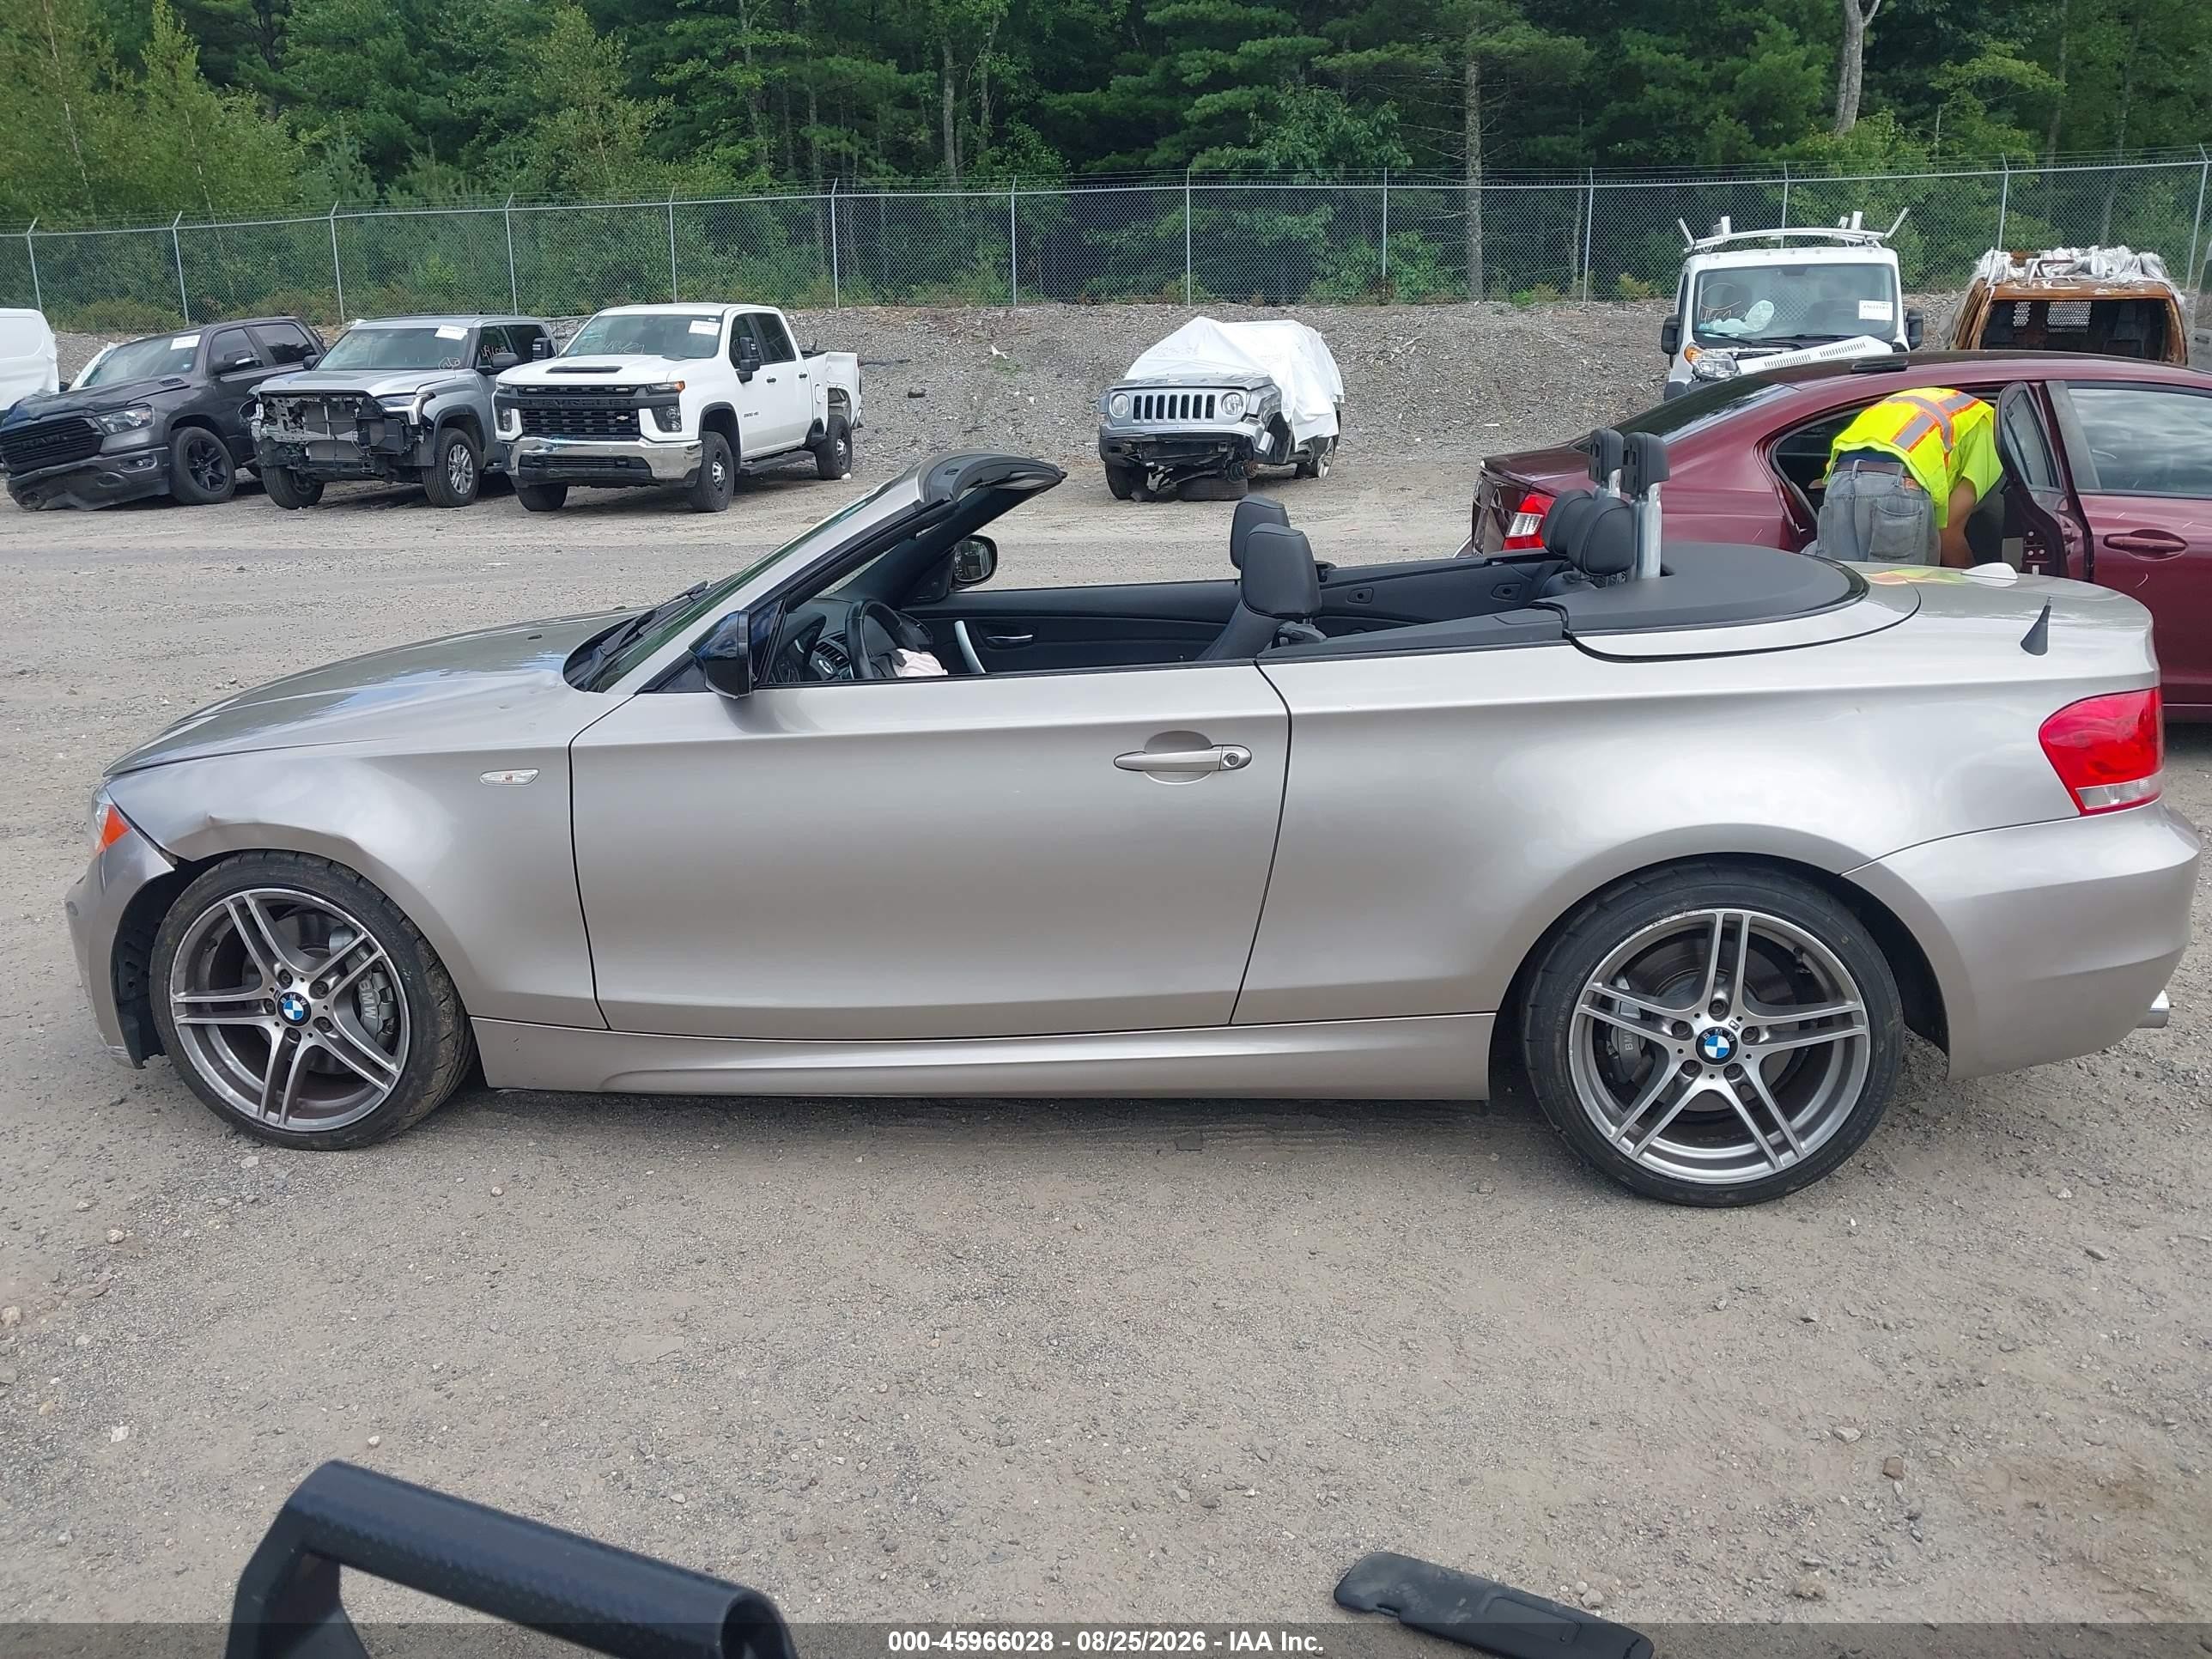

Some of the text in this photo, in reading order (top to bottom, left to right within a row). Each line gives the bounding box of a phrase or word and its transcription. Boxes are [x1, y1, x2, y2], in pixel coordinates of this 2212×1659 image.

[279, 994, 307, 1006] BMW
[358, 979, 377, 1019] BMW
[1623, 1030, 1634, 1051] BM
[1703, 1029, 1735, 1043] BMW
